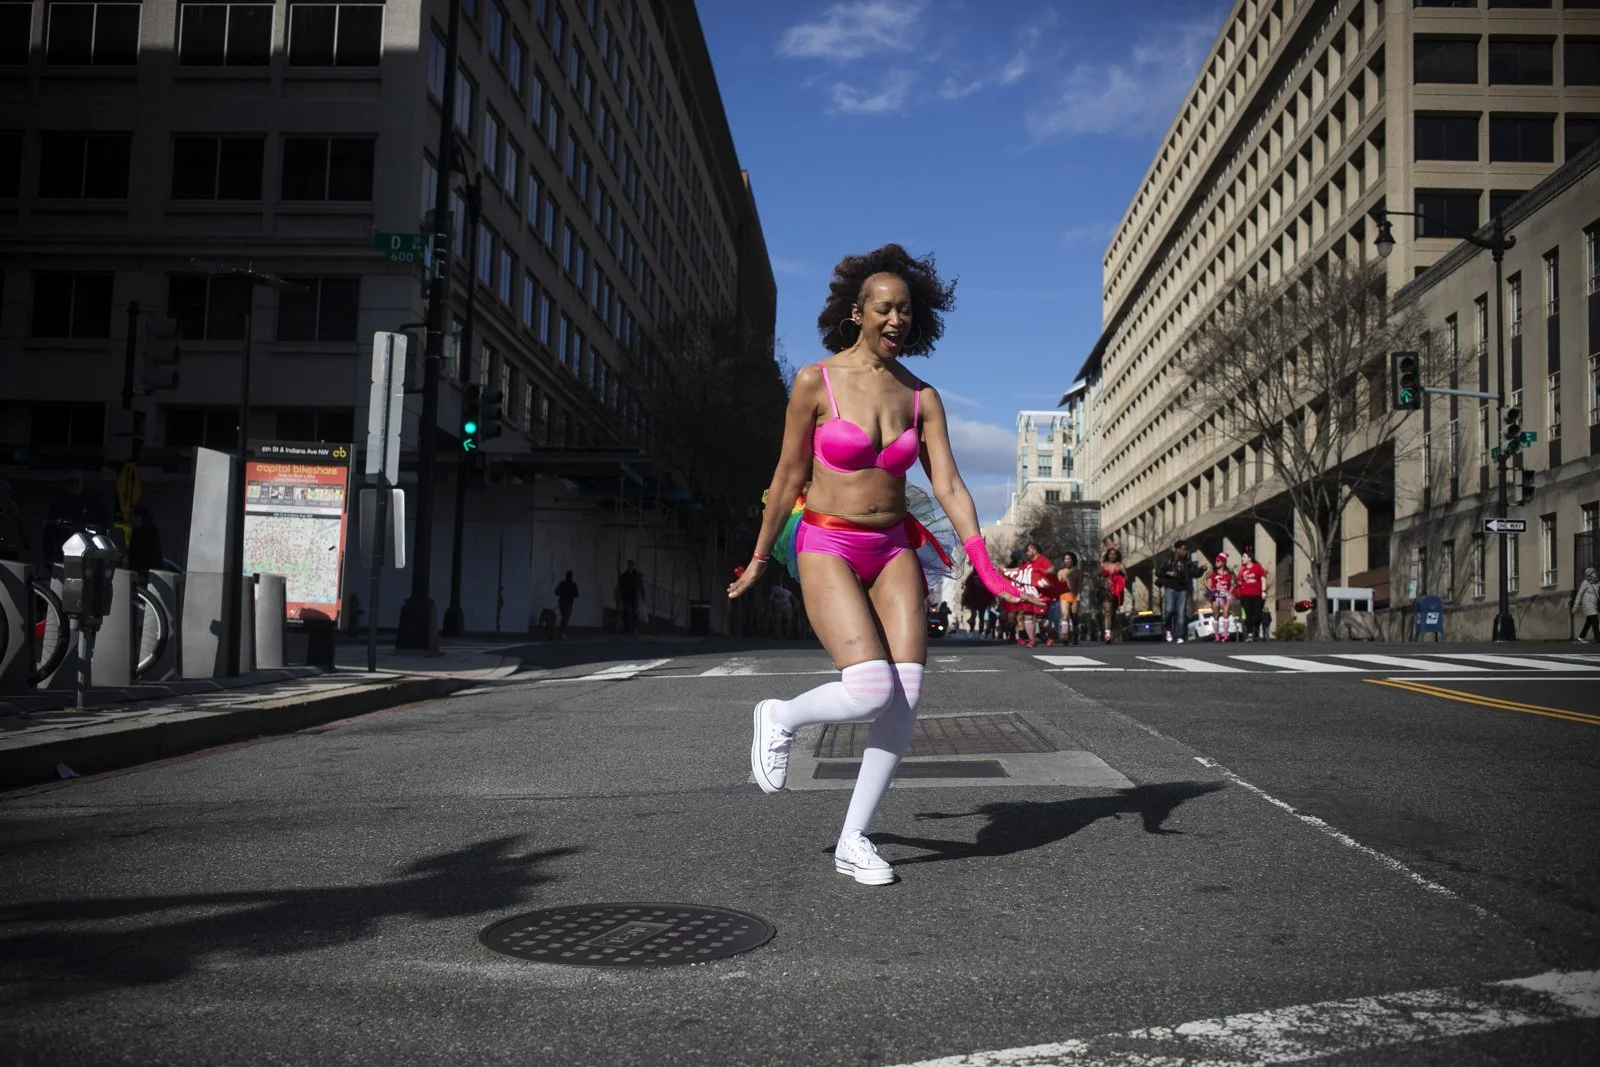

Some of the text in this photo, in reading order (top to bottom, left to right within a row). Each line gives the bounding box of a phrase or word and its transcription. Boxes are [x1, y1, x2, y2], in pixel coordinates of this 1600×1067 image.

[391, 235, 401, 250] D
[391, 252, 413, 262] 600
[285, 446, 306, 454] Indiana
[256, 464, 338, 475] capital bikeshare
